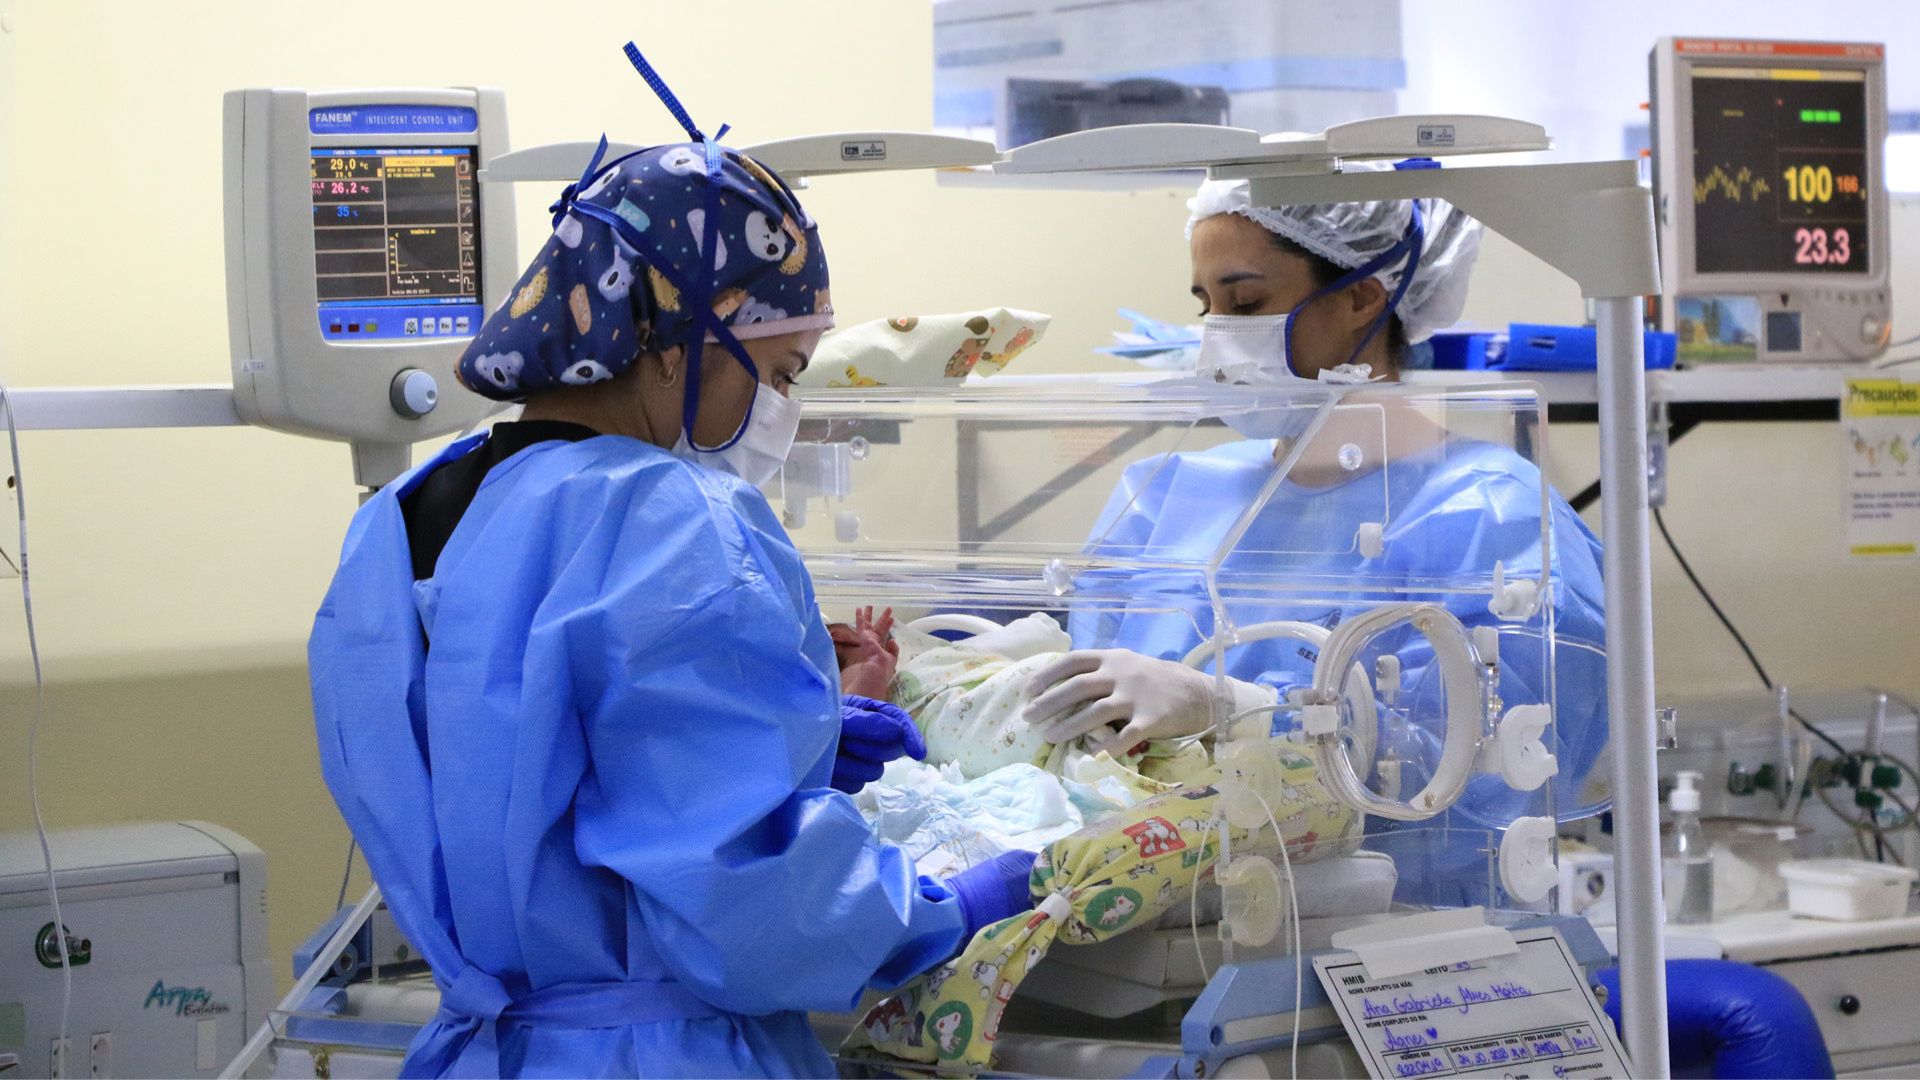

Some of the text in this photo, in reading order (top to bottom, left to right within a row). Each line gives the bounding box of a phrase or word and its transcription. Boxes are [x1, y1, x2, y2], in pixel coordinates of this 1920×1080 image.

[315, 112, 352, 123] FANEM
[365, 114, 463, 125] INTELLIGENT CONTROL UNIT
[330, 158, 356, 170] 29,0
[331, 182, 357, 194] 26,2
[1784, 165, 1833, 202] 100
[336, 205, 350, 217] 35
[1795, 227, 1850, 264] 23.3
[1342, 975, 1365, 986] HMIB
[1364, 983, 1392, 993] COMPLETO
[1363, 997, 1392, 1019] Ana
[1393, 991, 1455, 1014] Gabriela
[1382, 1018, 1409, 1026] COMPLETO
[1470, 1041, 1500, 1050] NASCIMENTO
